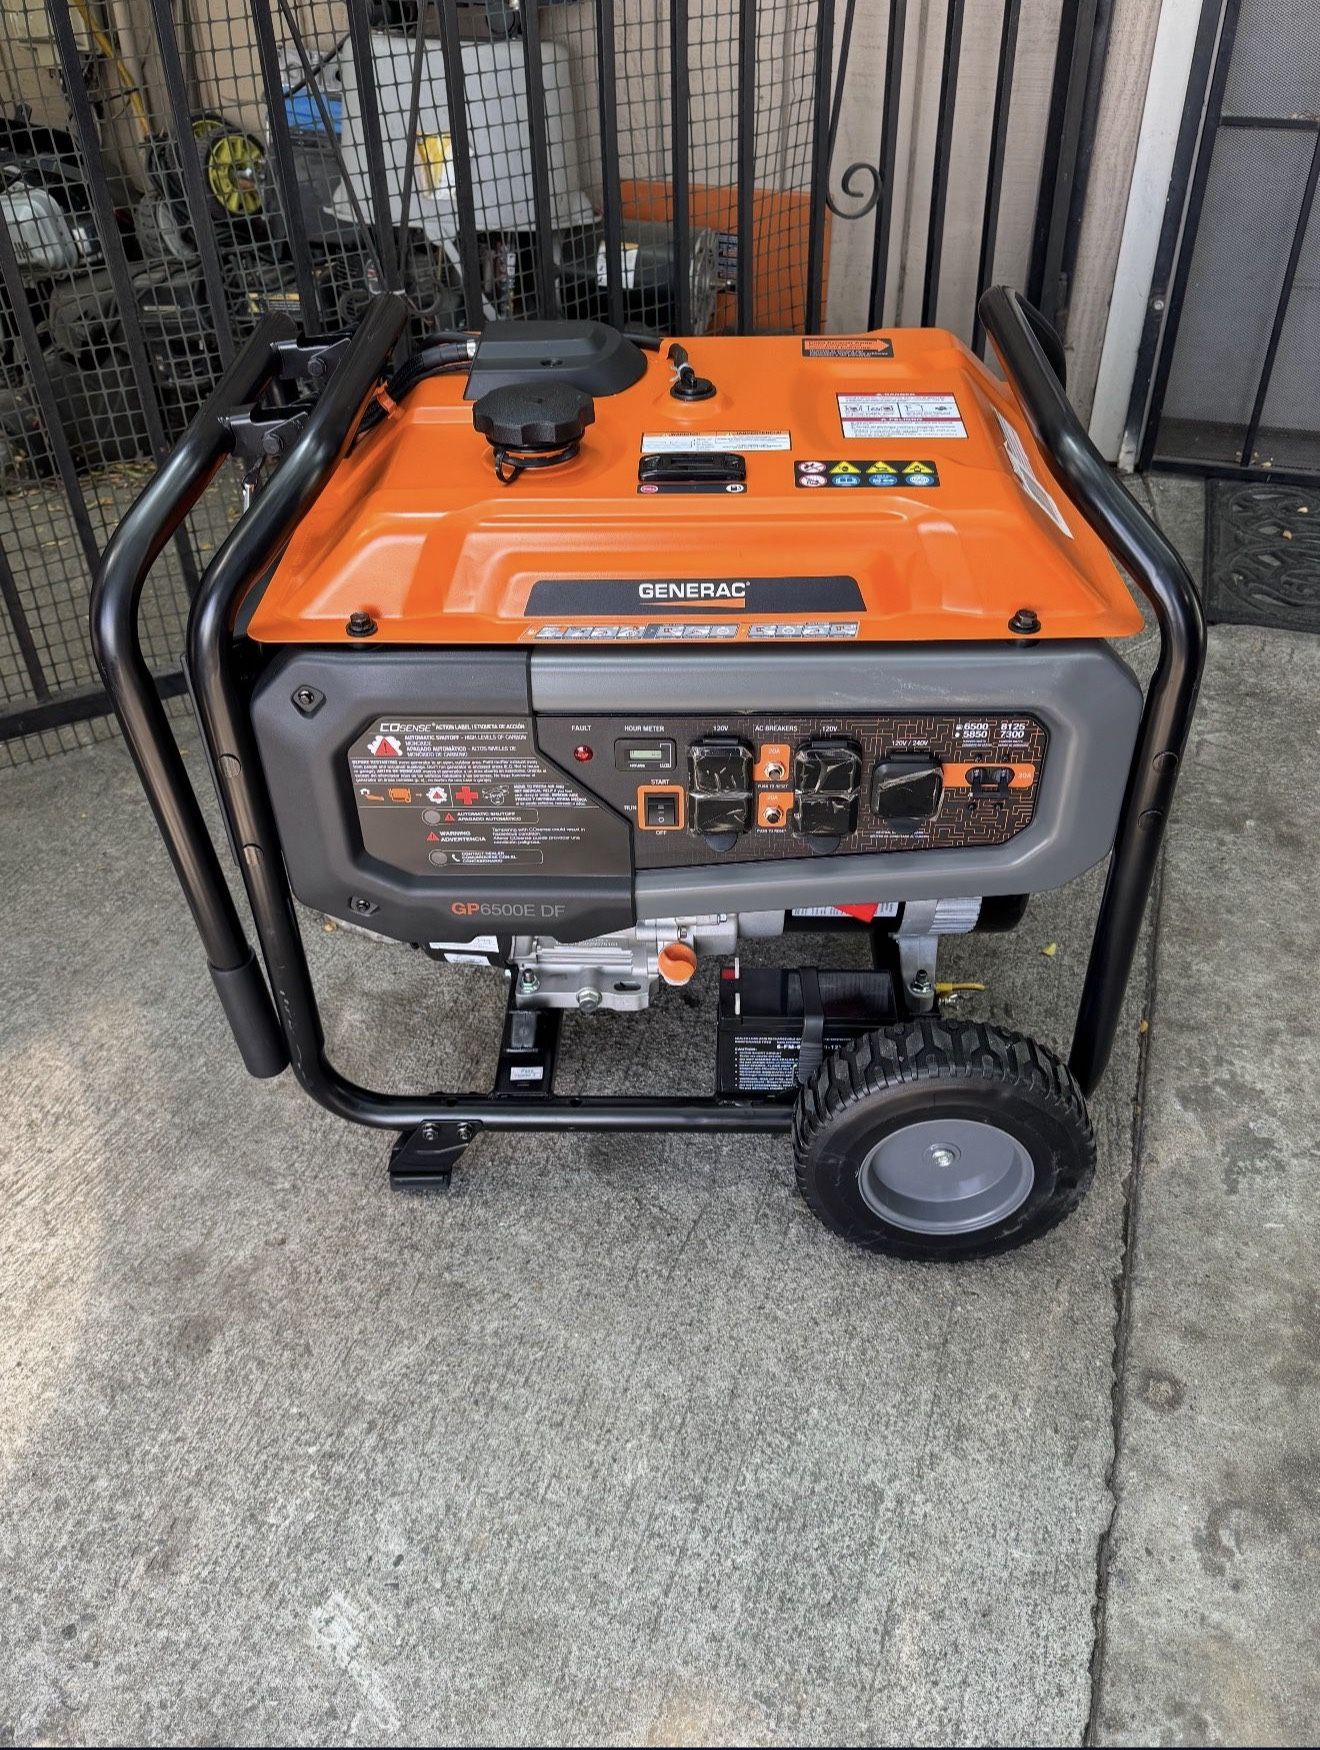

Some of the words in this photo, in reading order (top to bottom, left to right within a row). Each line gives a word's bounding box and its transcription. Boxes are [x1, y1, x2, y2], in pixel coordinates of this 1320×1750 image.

[638, 581, 746, 598] GENERAC
[624, 725, 641, 733] HOUR
[642, 725, 665, 733] METER
[963, 722, 989, 731] 6500
[1000, 722, 1025, 731] 8125
[962, 730, 987, 738] 5850
[999, 730, 1024, 738] 7300
[451, 902, 536, 917] GP6500E
[541, 904, 566, 918] DF
